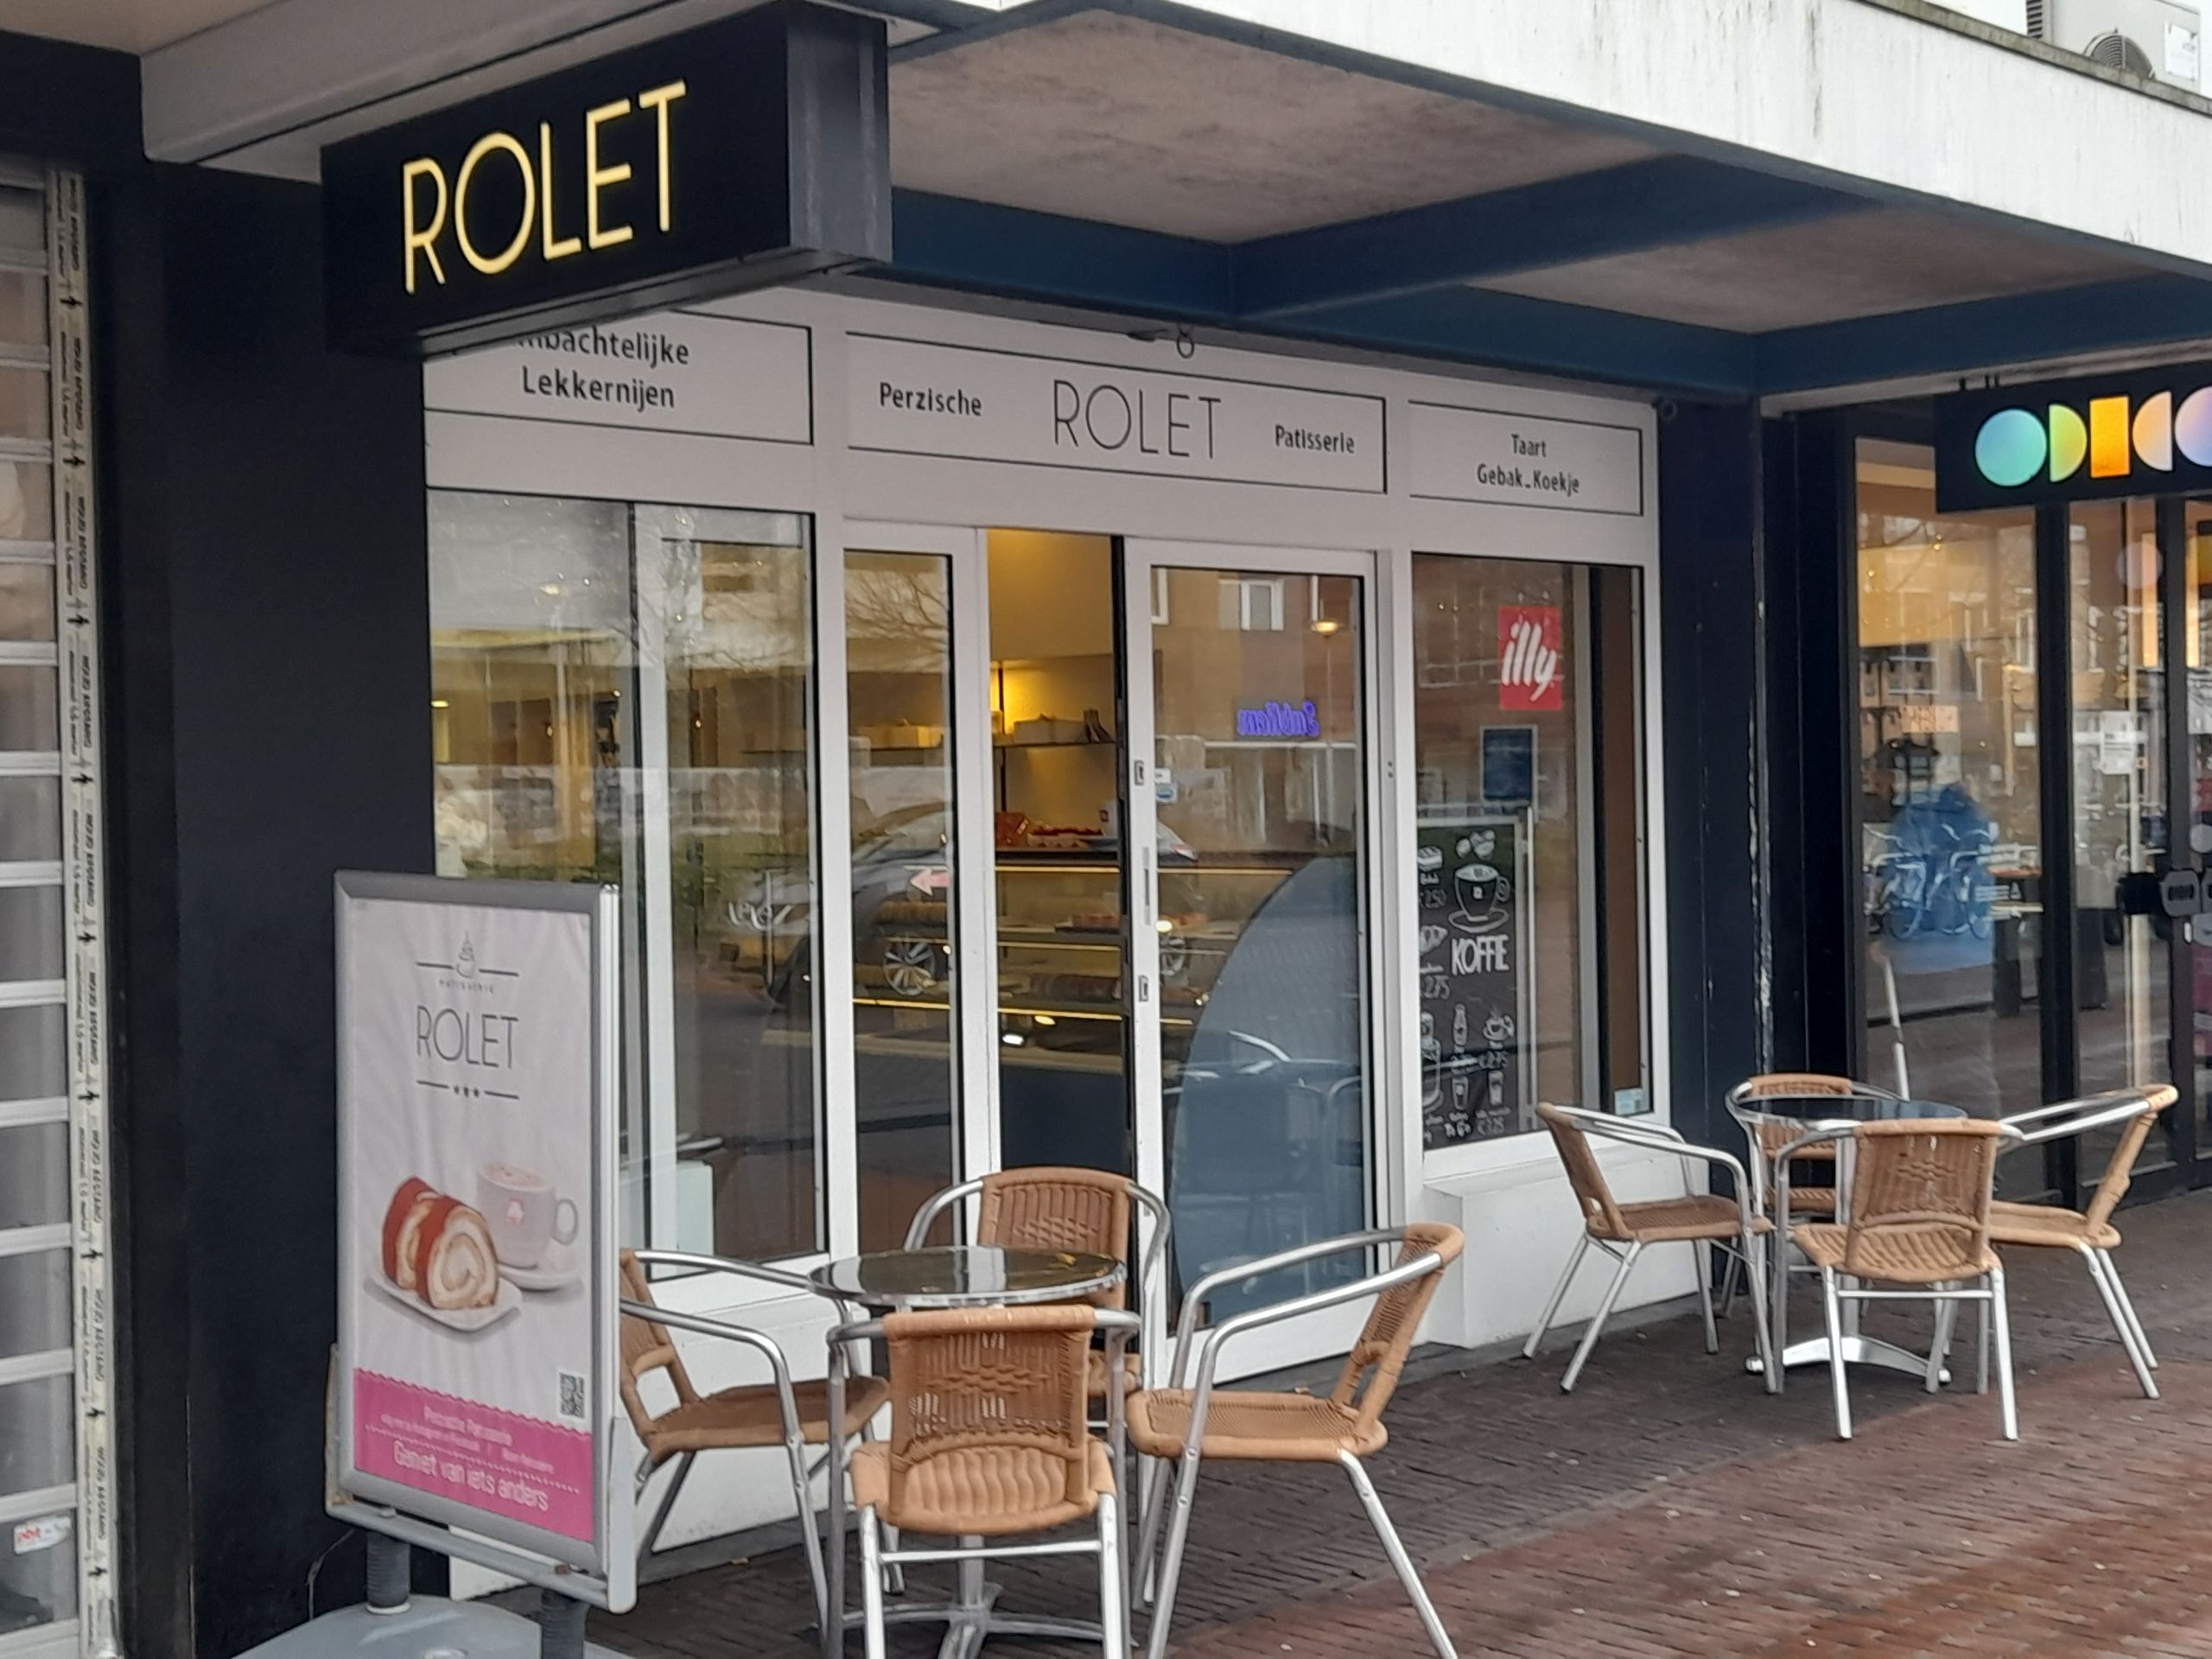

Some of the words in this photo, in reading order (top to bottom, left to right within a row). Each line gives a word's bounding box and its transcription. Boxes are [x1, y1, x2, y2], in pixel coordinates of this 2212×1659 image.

[403, 79, 686, 296] ROLET
[523, 365, 675, 412] Lekkernijen
[880, 382, 982, 417] Perzische
[1053, 379, 1221, 460] ROLET
[1274, 424, 1355, 454] Patisserie
[1511, 434, 1547, 458] Taart
[1501, 620, 1557, 702] illy
[1452, 934, 1510, 976] KOFFE
[416, 1005, 519, 1069] ROLET
[496, 1478, 549, 1512] anders
